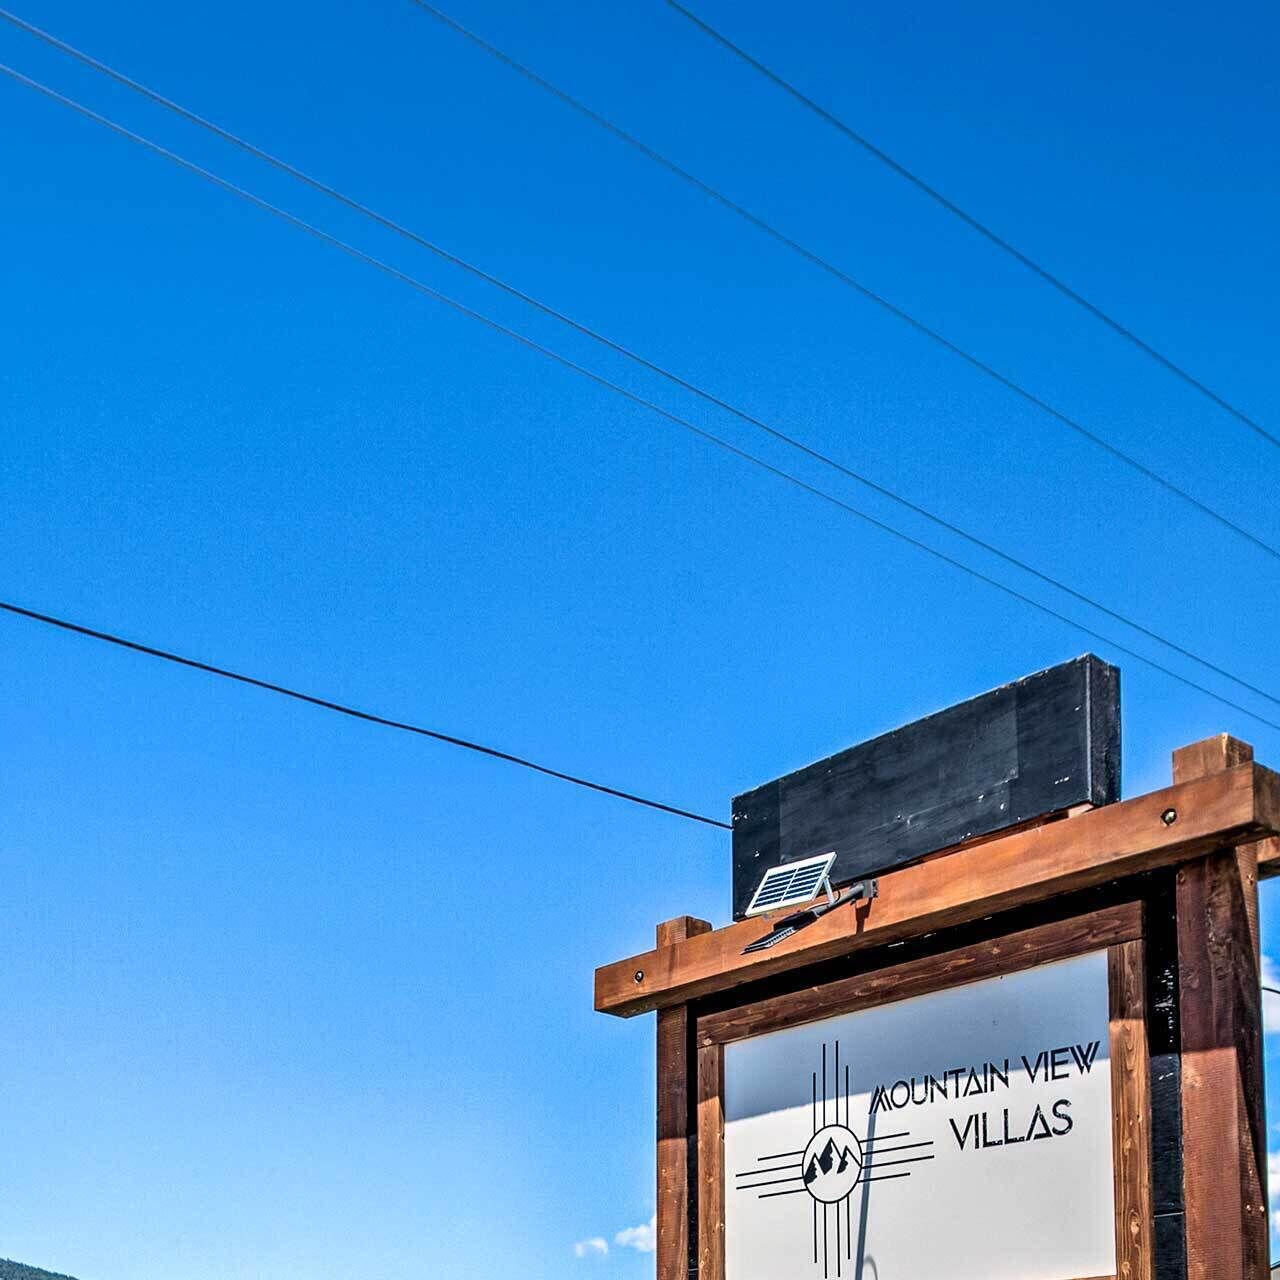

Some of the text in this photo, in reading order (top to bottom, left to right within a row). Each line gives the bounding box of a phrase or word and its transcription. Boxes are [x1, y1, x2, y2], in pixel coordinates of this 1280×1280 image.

[868, 1040, 1101, 1115] MOUNTAIN VIEW
[949, 1099, 1074, 1151] VILLAS
